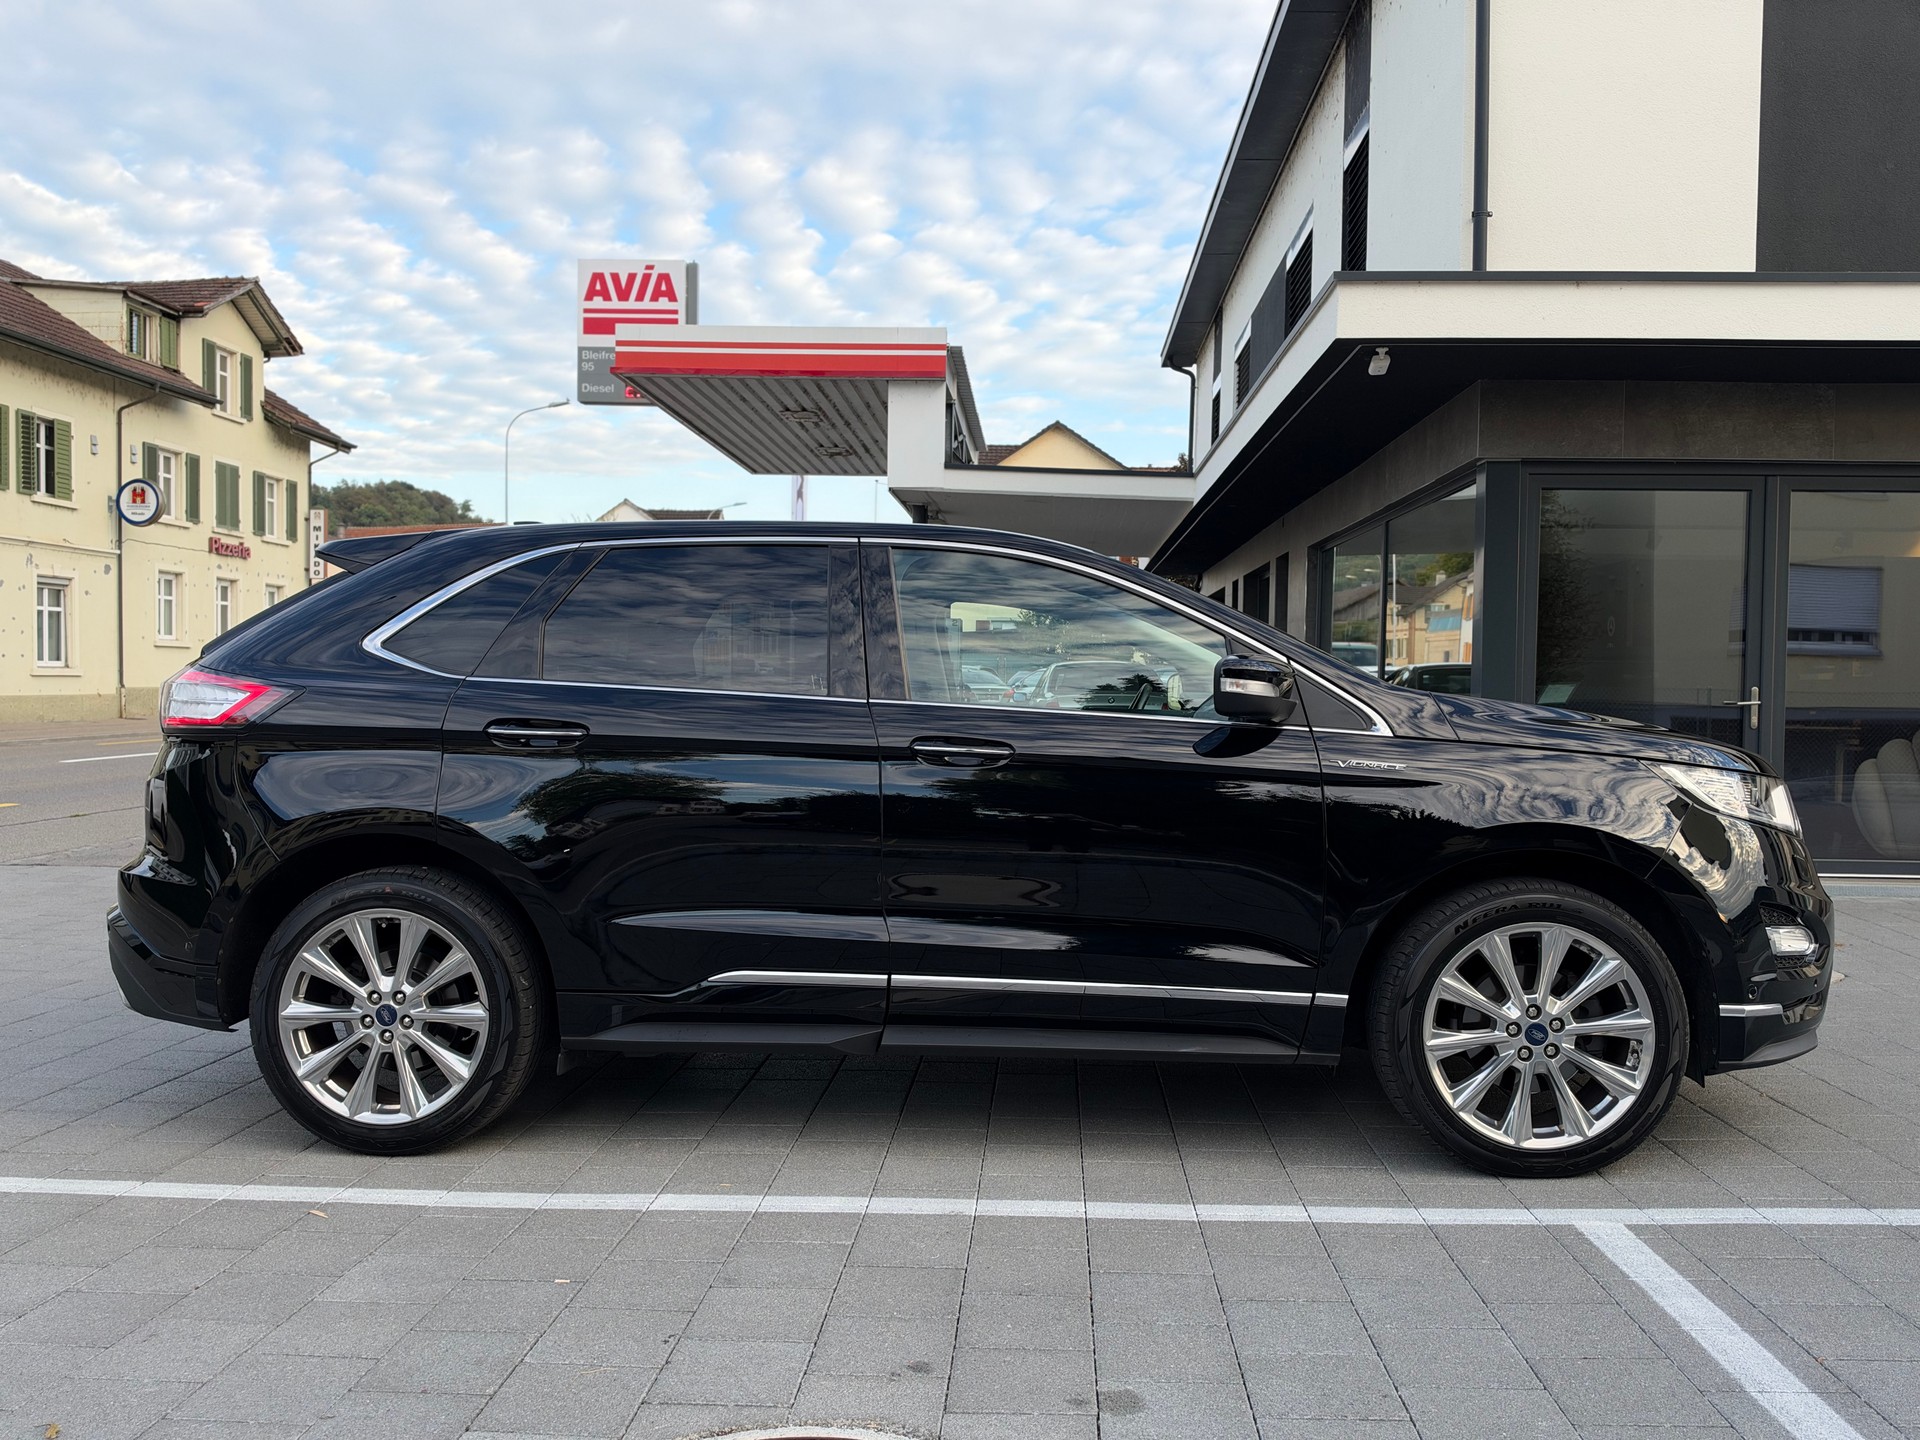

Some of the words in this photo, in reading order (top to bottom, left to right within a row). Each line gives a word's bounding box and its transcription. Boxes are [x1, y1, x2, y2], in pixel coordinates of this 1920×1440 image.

[583, 264, 679, 302] AVIA
[581, 361, 595, 372] 95
[581, 383, 615, 393] Diesel
[211, 537, 251, 560] Pizzeria
[312, 525, 322, 576] MIKDO
